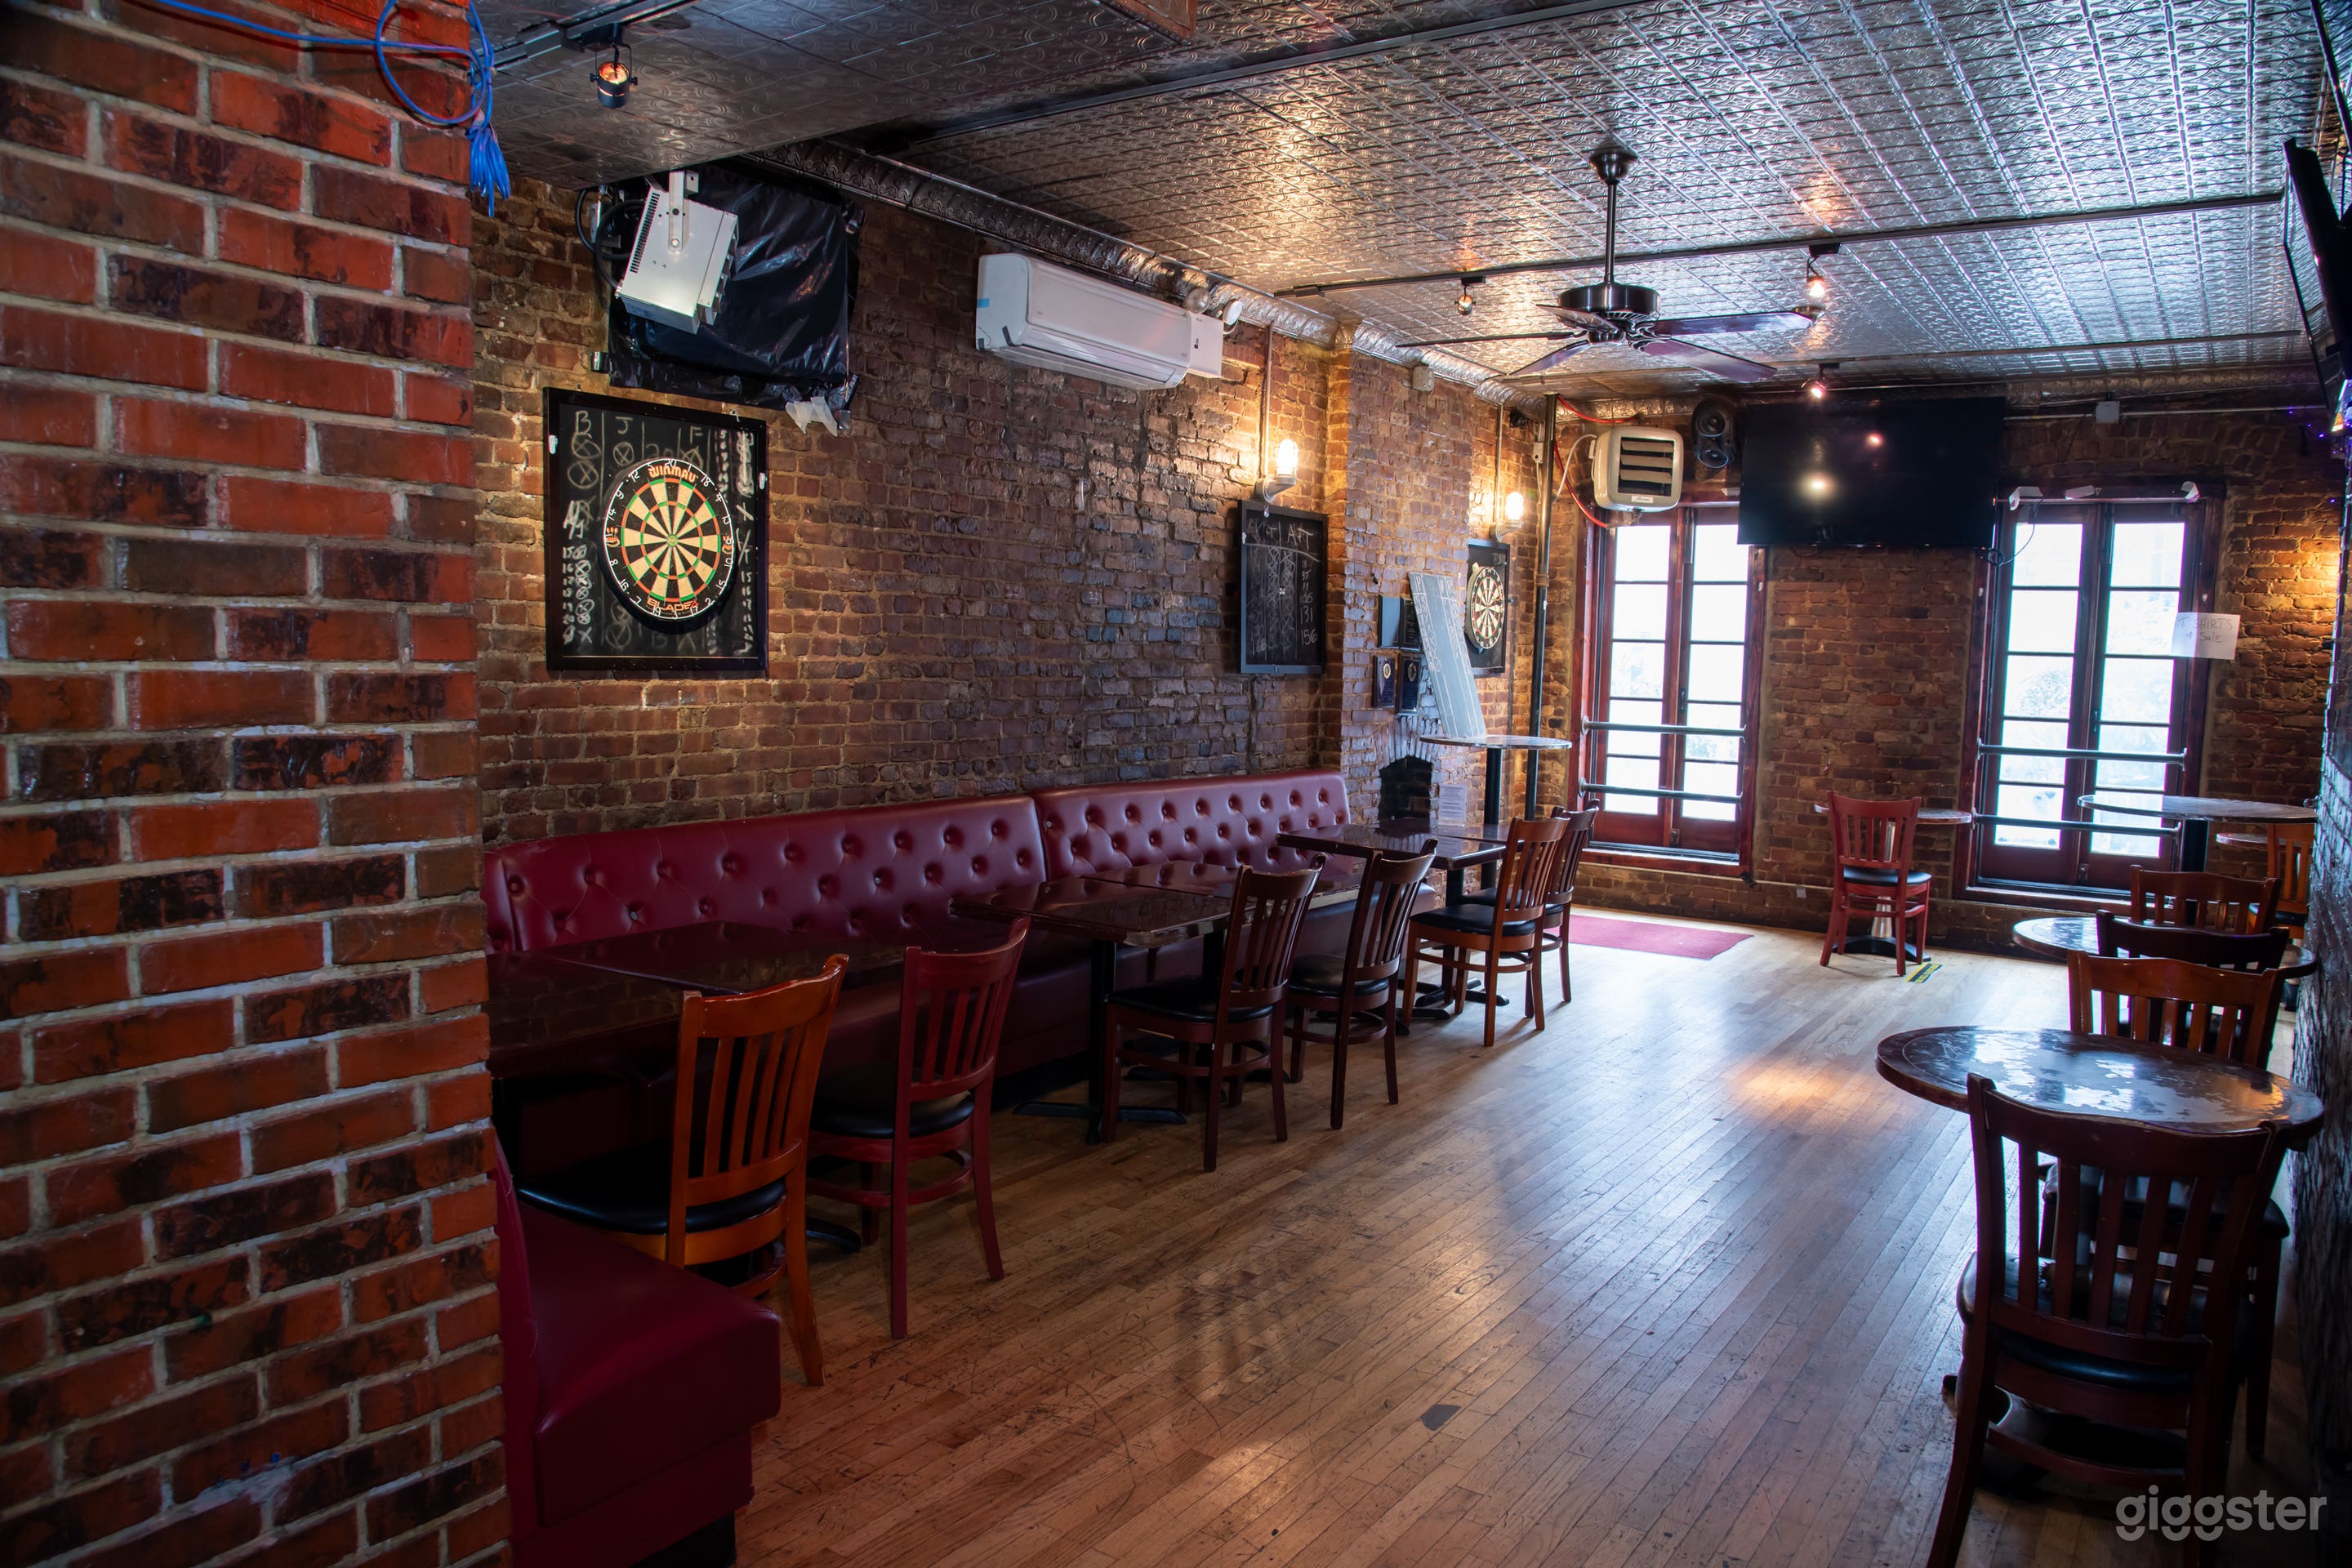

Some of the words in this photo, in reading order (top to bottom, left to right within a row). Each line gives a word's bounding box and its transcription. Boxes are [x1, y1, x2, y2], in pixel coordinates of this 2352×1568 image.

[615, 416, 634, 434] J
[664, 458, 677, 468] 20
[648, 466, 697, 483] WINMAU
[700, 475, 711, 488] 18
[615, 490, 625, 500] 9
[715, 492, 723, 502] 4
[607, 508, 617, 522] 14
[609, 558, 619, 567] 8
[724, 557, 734, 568] 10
[619, 578, 630, 592] 16
[715, 579, 727, 591] 15
[2178, 616, 2189, 628] T
[2193, 617, 2234, 630] SHIRTS
[1300, 629, 1318, 646] 156
